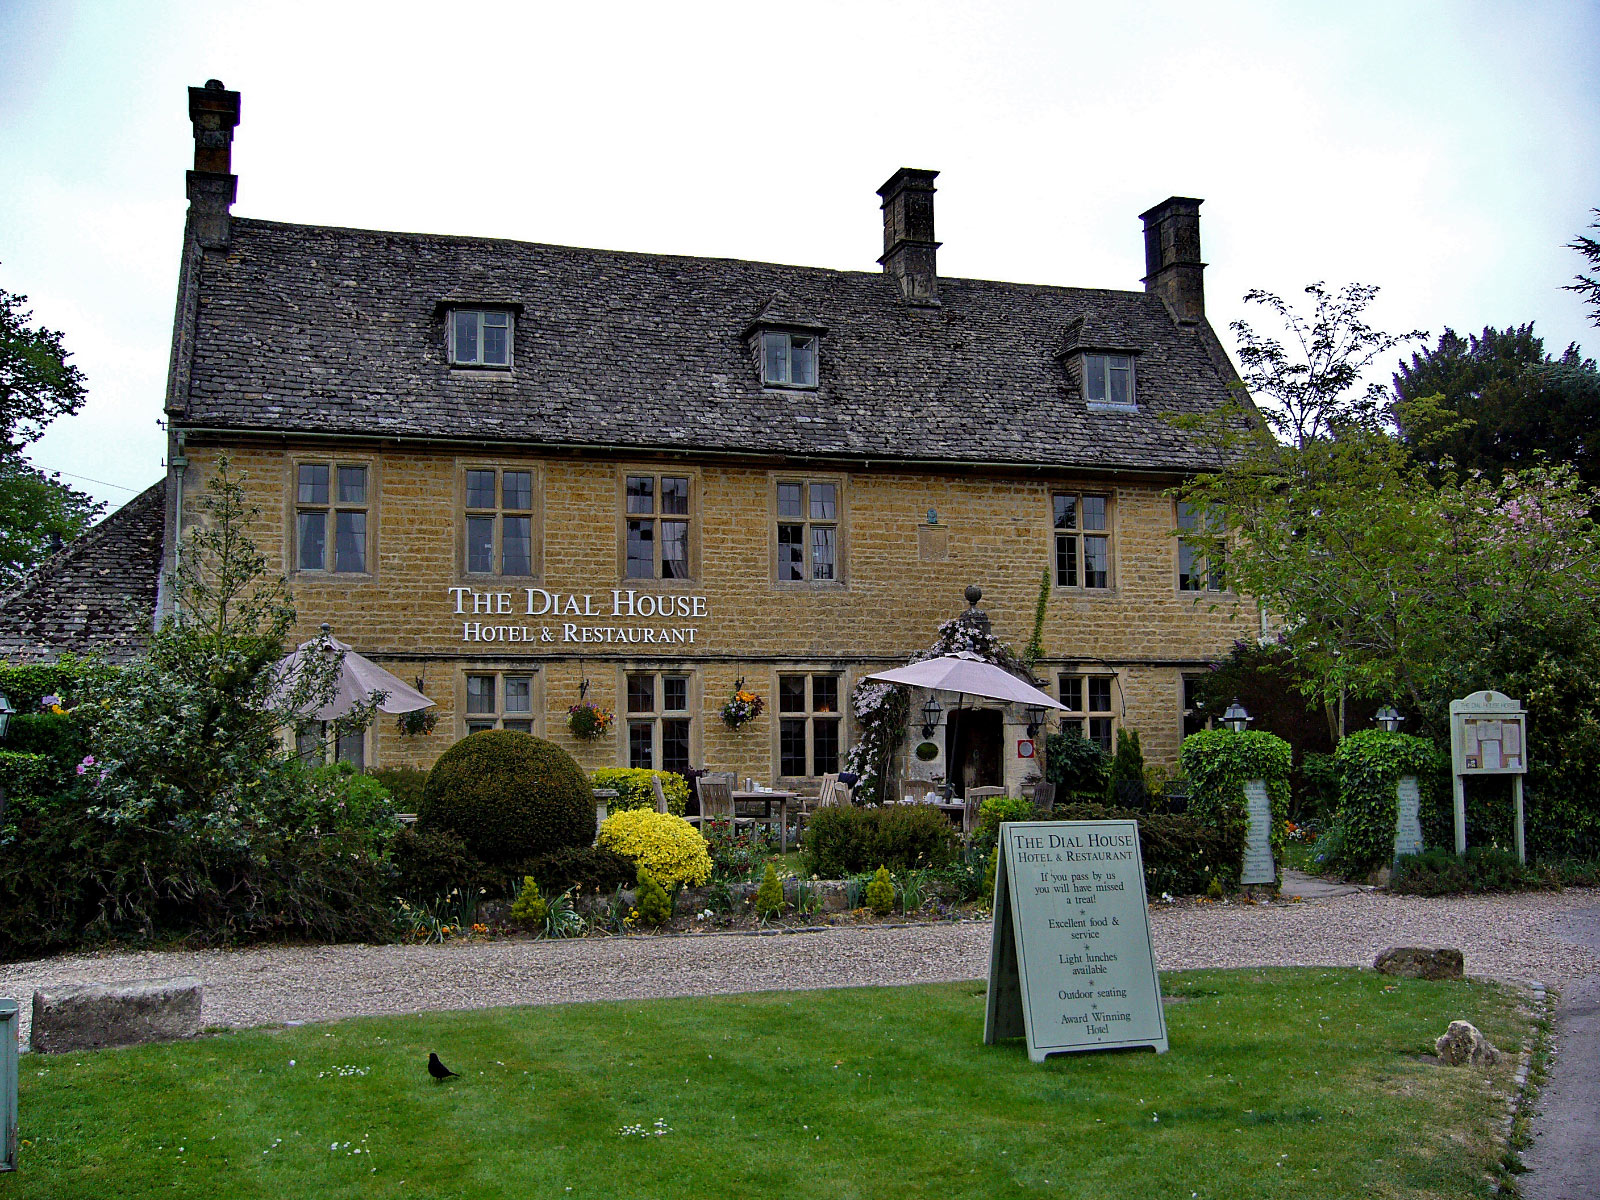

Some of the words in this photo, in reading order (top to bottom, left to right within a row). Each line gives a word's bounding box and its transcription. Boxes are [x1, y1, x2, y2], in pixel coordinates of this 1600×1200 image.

[448, 587, 513, 615] THE
[525, 588, 600, 616] DIAL
[610, 590, 708, 617] HOUSE
[462, 623, 534, 643] HOTEL
[541, 627, 554, 642] &
[563, 623, 697, 643] RESTAURANT
[1014, 836, 1043, 849] THE
[1049, 834, 1083, 848] DIAL
[1088, 834, 1133, 847] HOUSE
[1018, 852, 1052, 863] HOTEL
[1067, 851, 1132, 861] RESTAURANT
[1041, 872, 1048, 881] If
[1051, 873, 1067, 883] you
[1071, 873, 1089, 881] pass
[1093, 871, 1102, 881] by
[1035, 886, 1049, 895] you
[1054, 884, 1069, 893] will
[1074, 883, 1092, 892] have
[1096, 882, 1124, 891] missed
[1075, 895, 1096, 904] treat!
[1049, 919, 1085, 928] Excellent
[1090, 917, 1108, 926] food
[1071, 931, 1099, 939] service
[1059, 954, 1082, 965] Light
[1086, 952, 1117, 962] lunches
[1073, 965, 1107, 975] available
[1058, 989, 1093, 1000] Outdoor
[1097, 988, 1127, 999] seating
[1061, 1013, 1088, 1024] Award
[1092, 1011, 1131, 1021] Winning
[1087, 1024, 1109, 1034] Hotel
